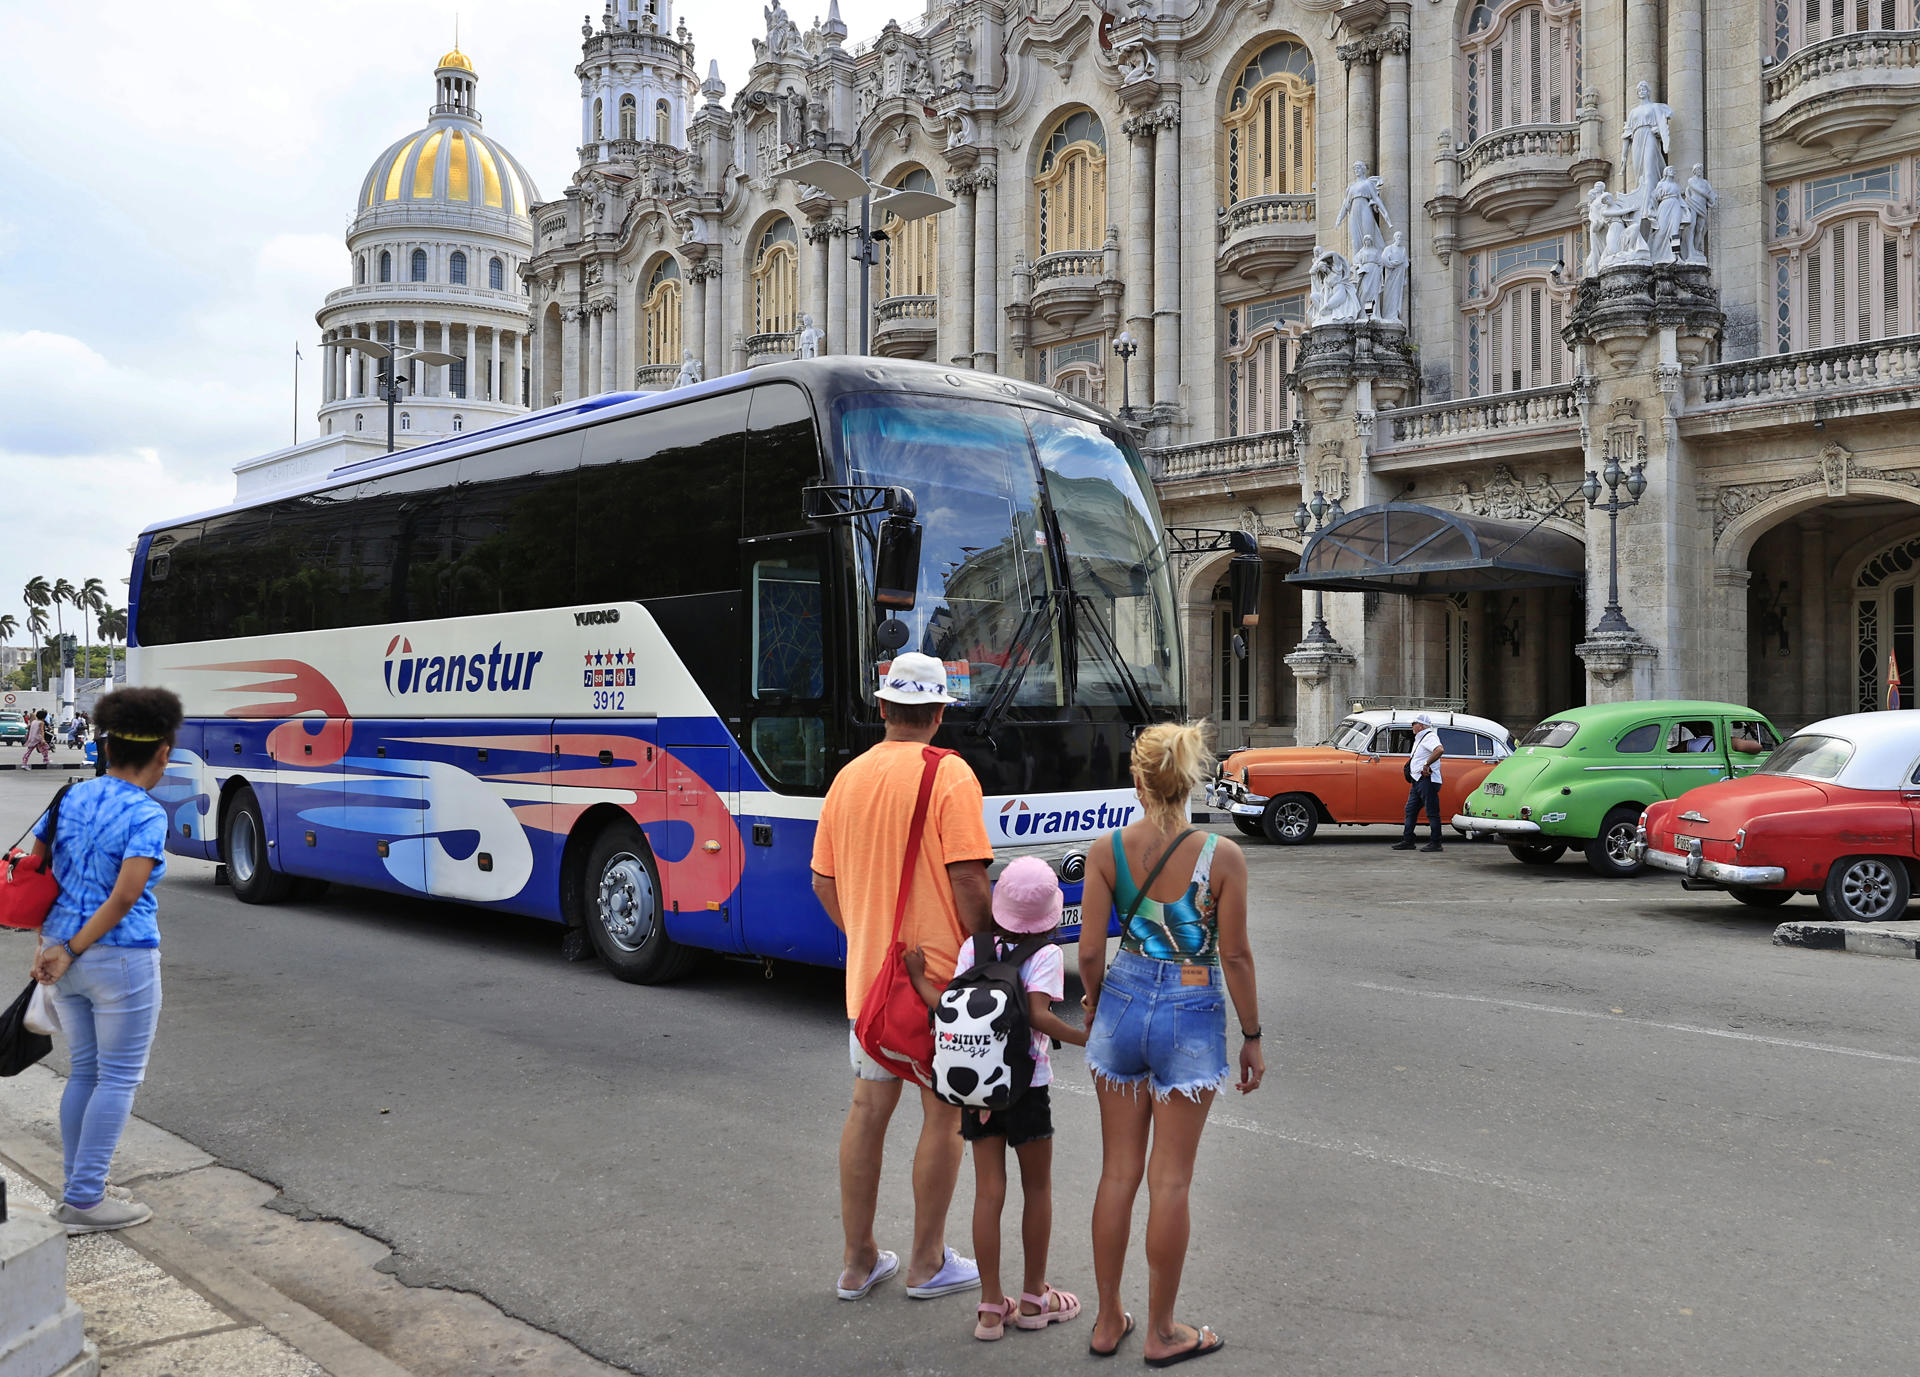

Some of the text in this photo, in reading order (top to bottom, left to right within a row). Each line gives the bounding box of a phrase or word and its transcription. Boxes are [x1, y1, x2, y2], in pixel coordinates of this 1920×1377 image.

[574, 609, 620, 626] YUTONG
[593, 690, 625, 710] 3912
[940, 1043, 991, 1058] energy
